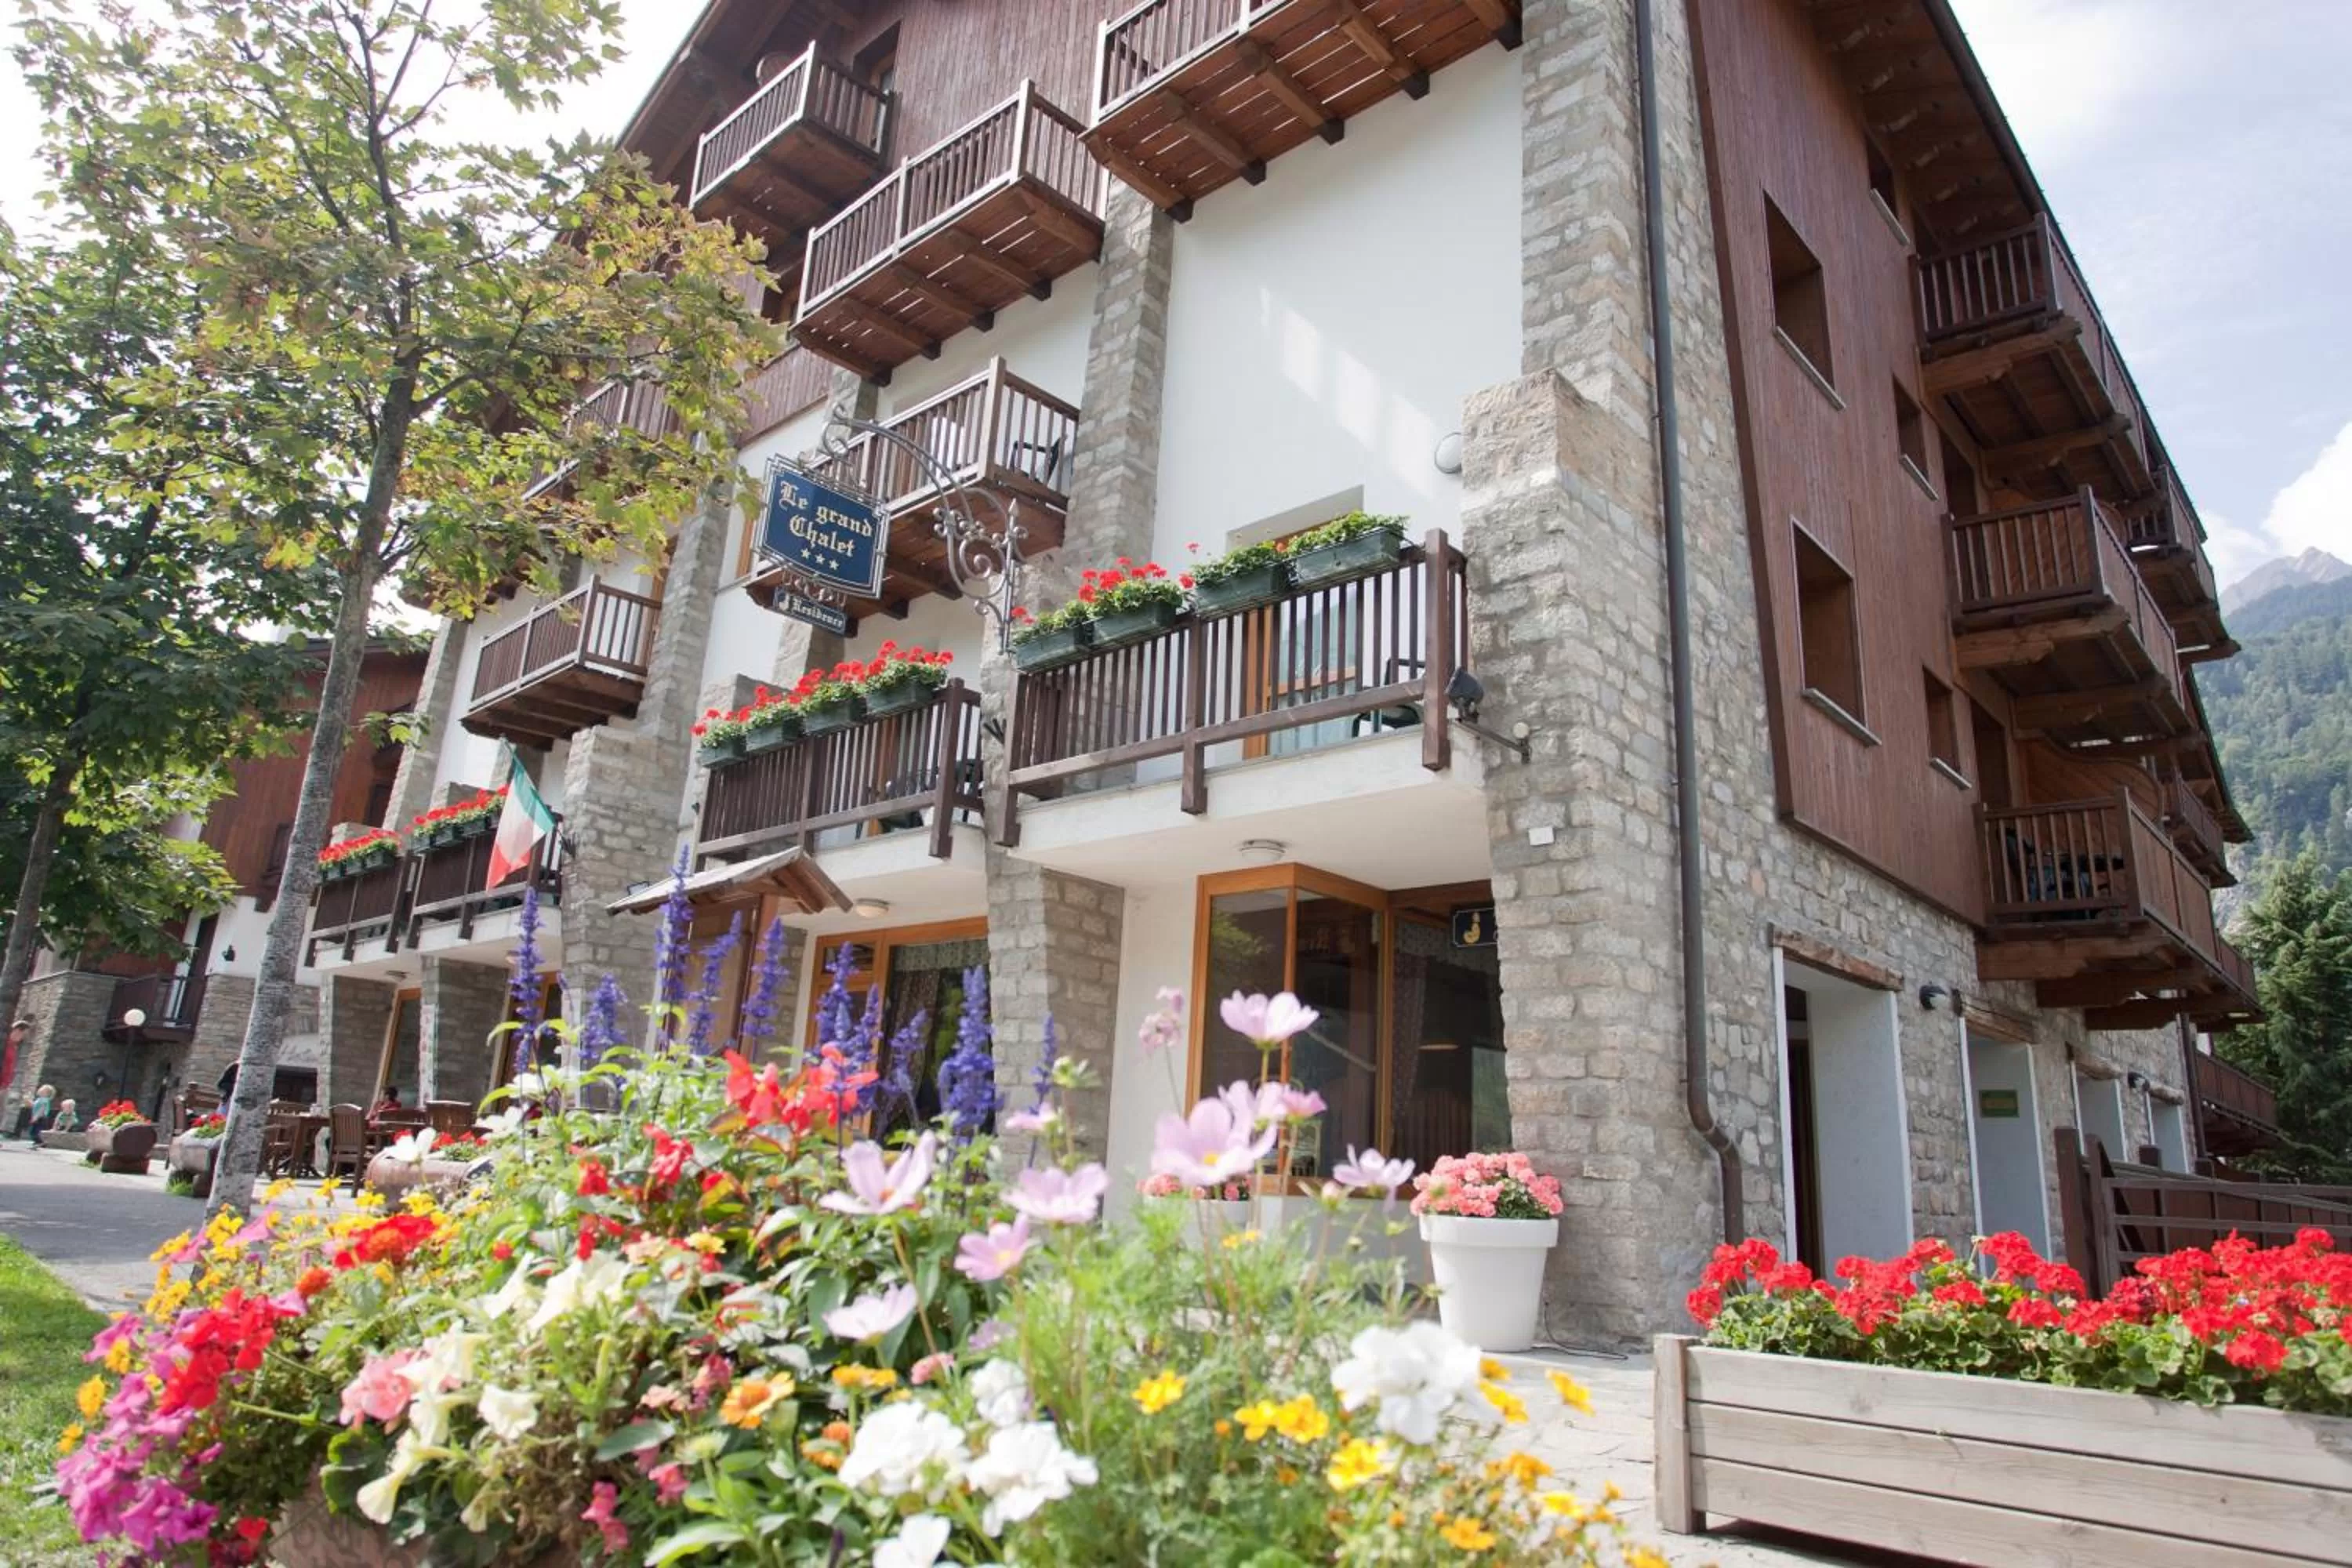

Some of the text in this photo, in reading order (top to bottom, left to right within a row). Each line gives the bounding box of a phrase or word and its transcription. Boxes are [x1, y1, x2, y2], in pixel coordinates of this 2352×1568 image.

[779, 480, 873, 538] Le grand
[789, 514, 855, 557] Chalet
